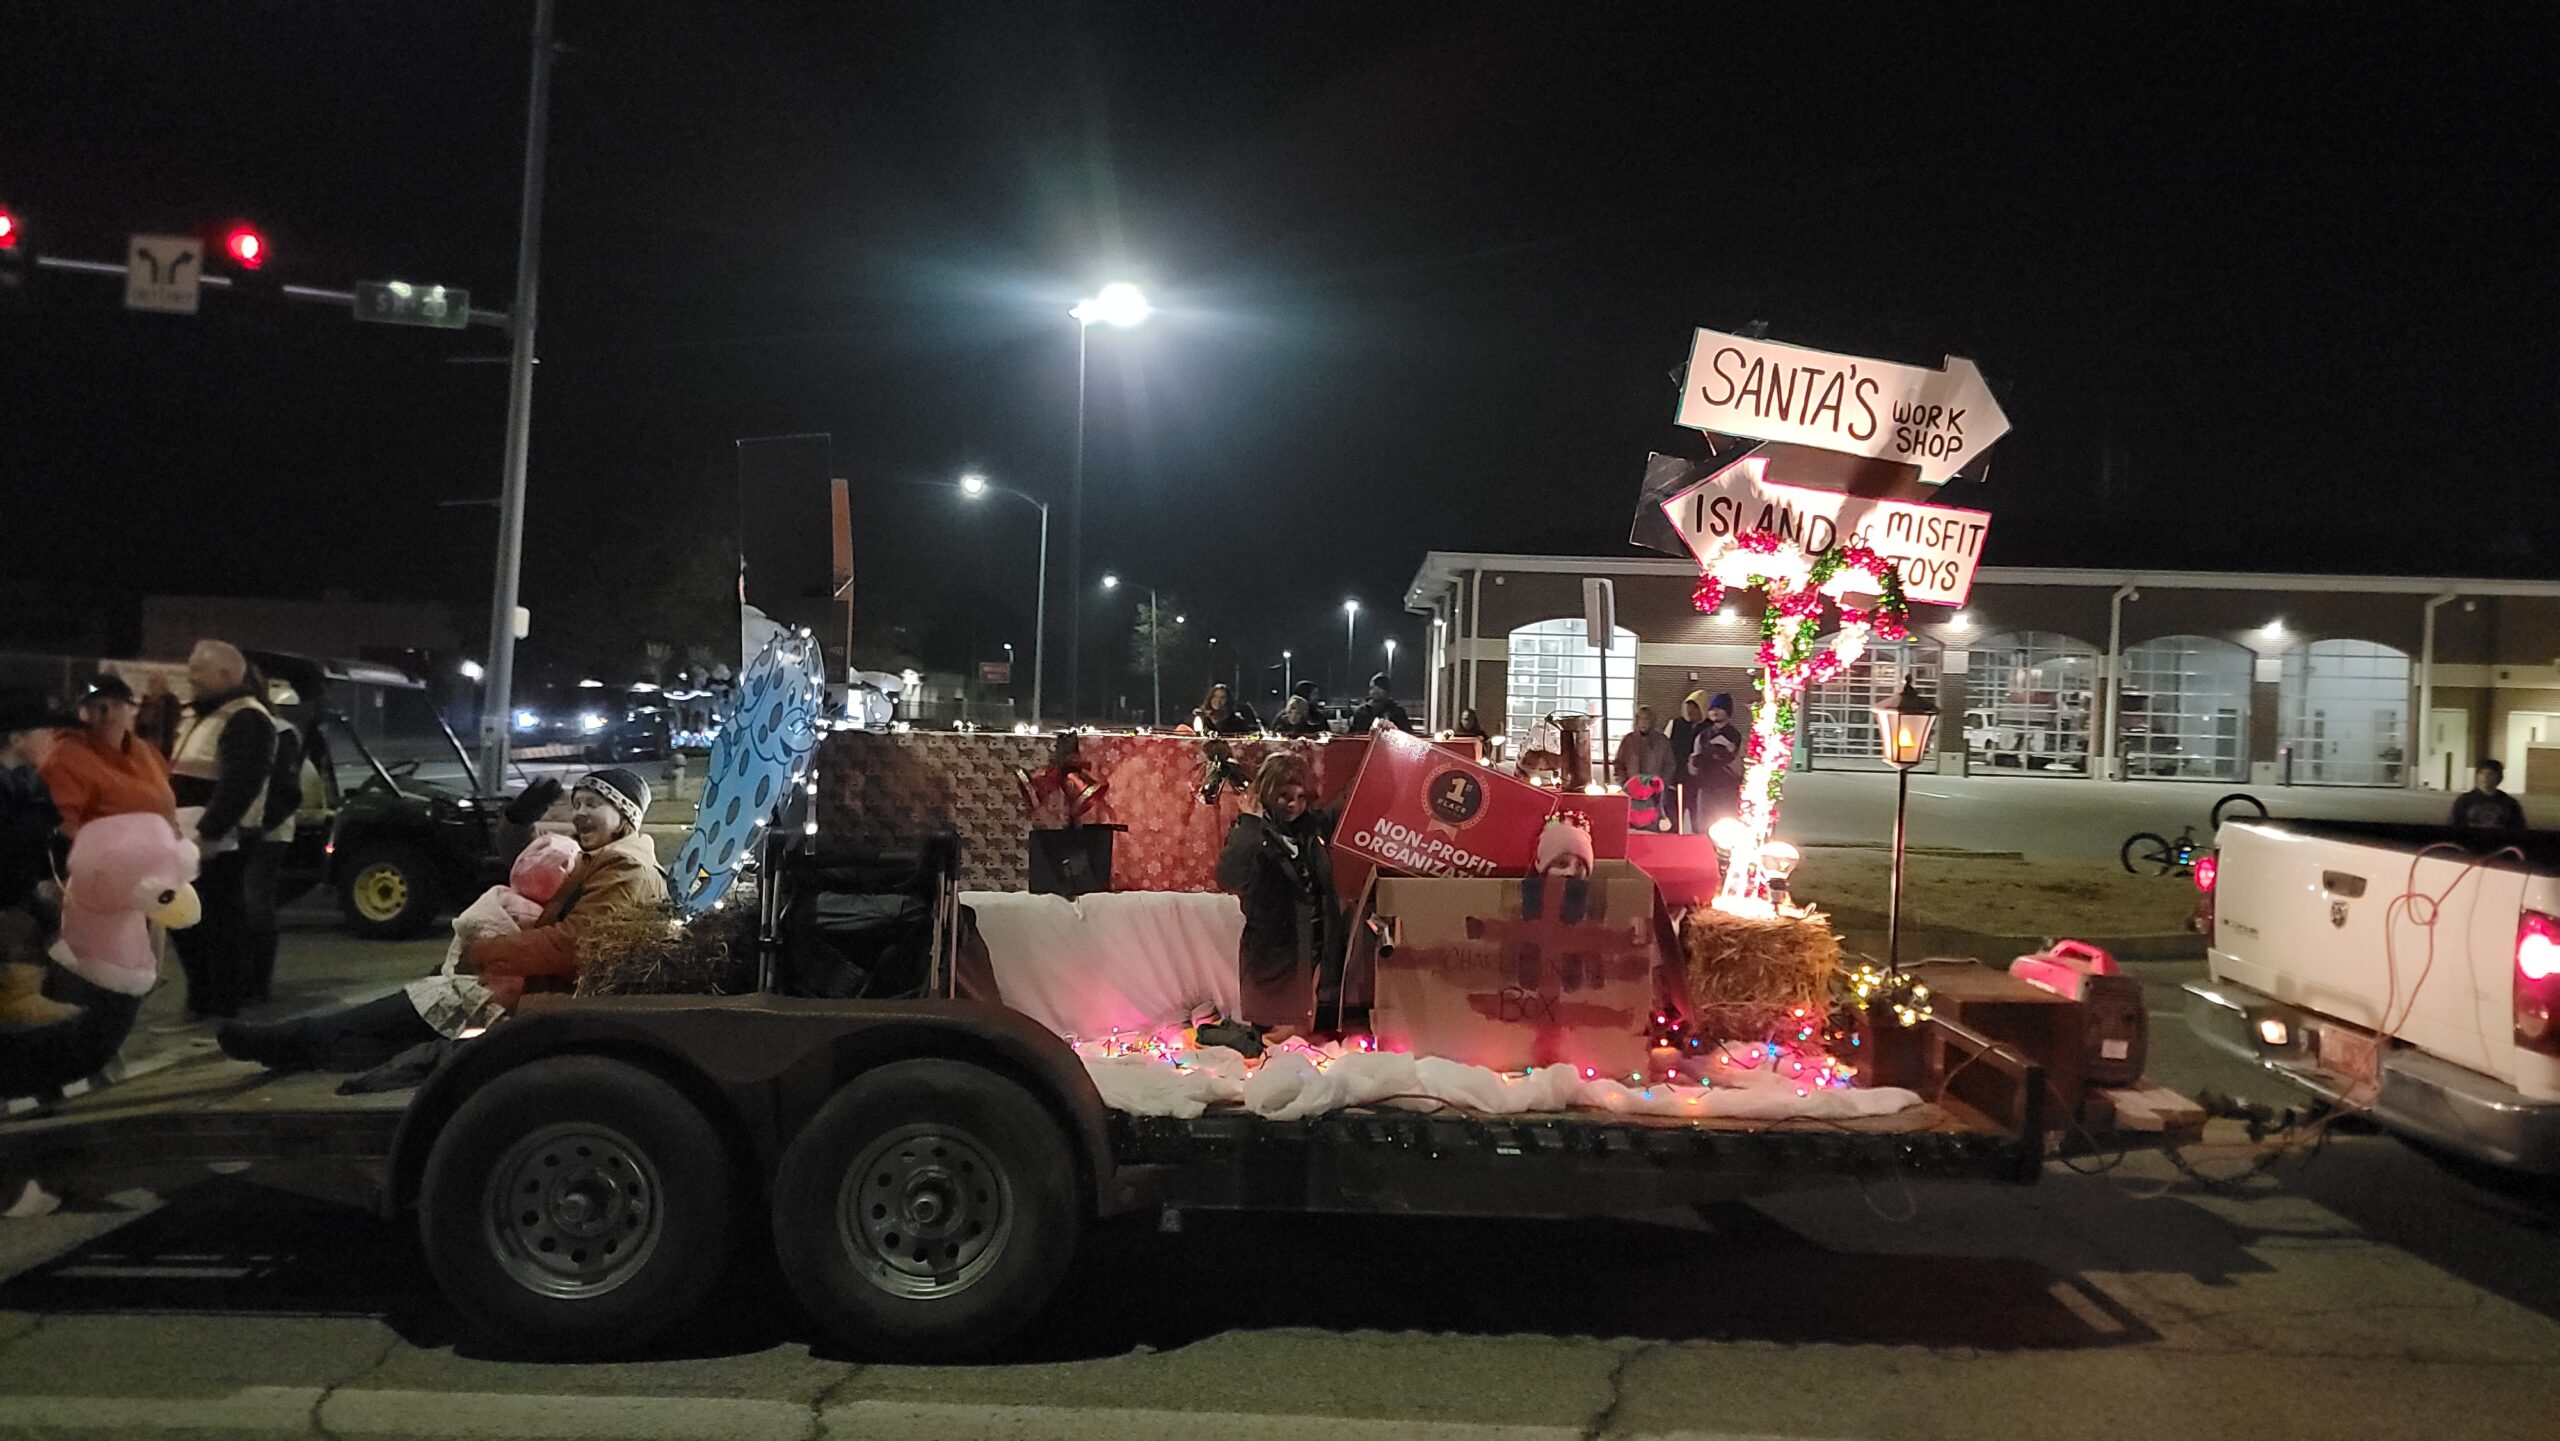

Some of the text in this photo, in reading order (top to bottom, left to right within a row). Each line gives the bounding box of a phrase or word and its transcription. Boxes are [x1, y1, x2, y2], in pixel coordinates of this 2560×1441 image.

[1701, 347, 1880, 441] SANTA'S
[1892, 399, 1967, 435] WORK
[1896, 426, 1964, 462] SHOP
[1696, 493, 1875, 557] ISLAND of
[1886, 511, 1986, 558] MISFIT
[1886, 554, 1960, 592] TOYS
[1436, 798, 1467, 815] PLACE
[1353, 830, 1475, 879] ORGANIZAT
[1373, 817, 1498, 876] NON-PROFIT
[1499, 985, 1561, 1023] BOX
